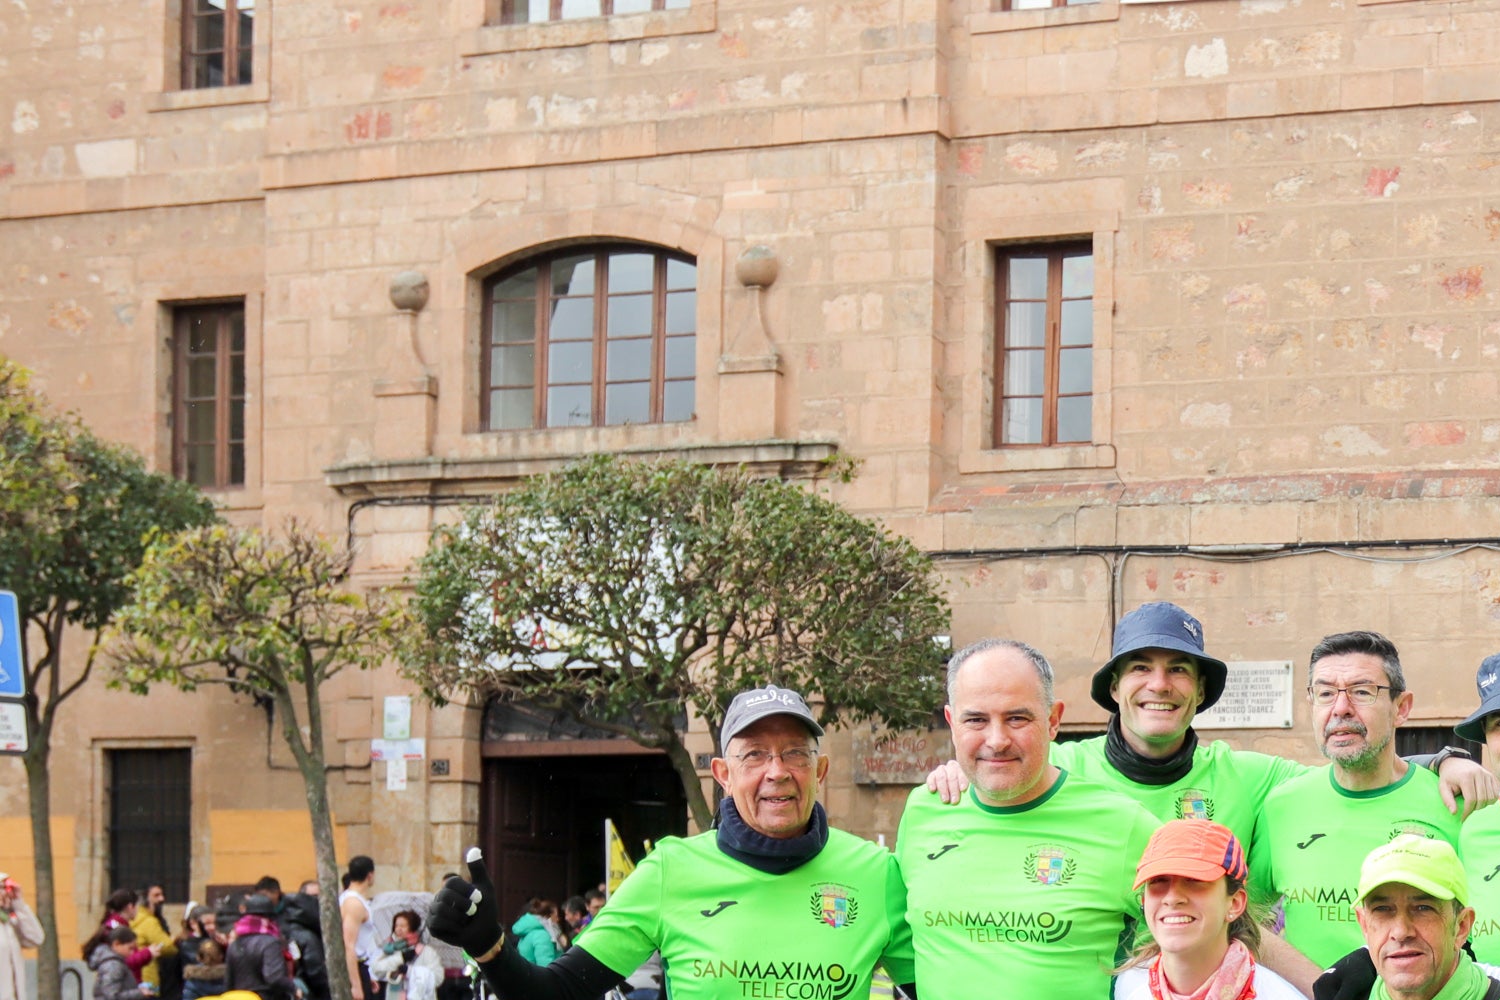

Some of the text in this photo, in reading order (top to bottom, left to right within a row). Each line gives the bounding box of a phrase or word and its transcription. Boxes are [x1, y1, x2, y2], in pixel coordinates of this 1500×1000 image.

[924, 910, 1056, 930] SANMAXIMO
[1317, 905, 1356, 923] TELE
[966, 927, 1046, 944] TELECOM
[693, 959, 845, 982] SANMAXIMO
[738, 980, 833, 1000] TELECOM
